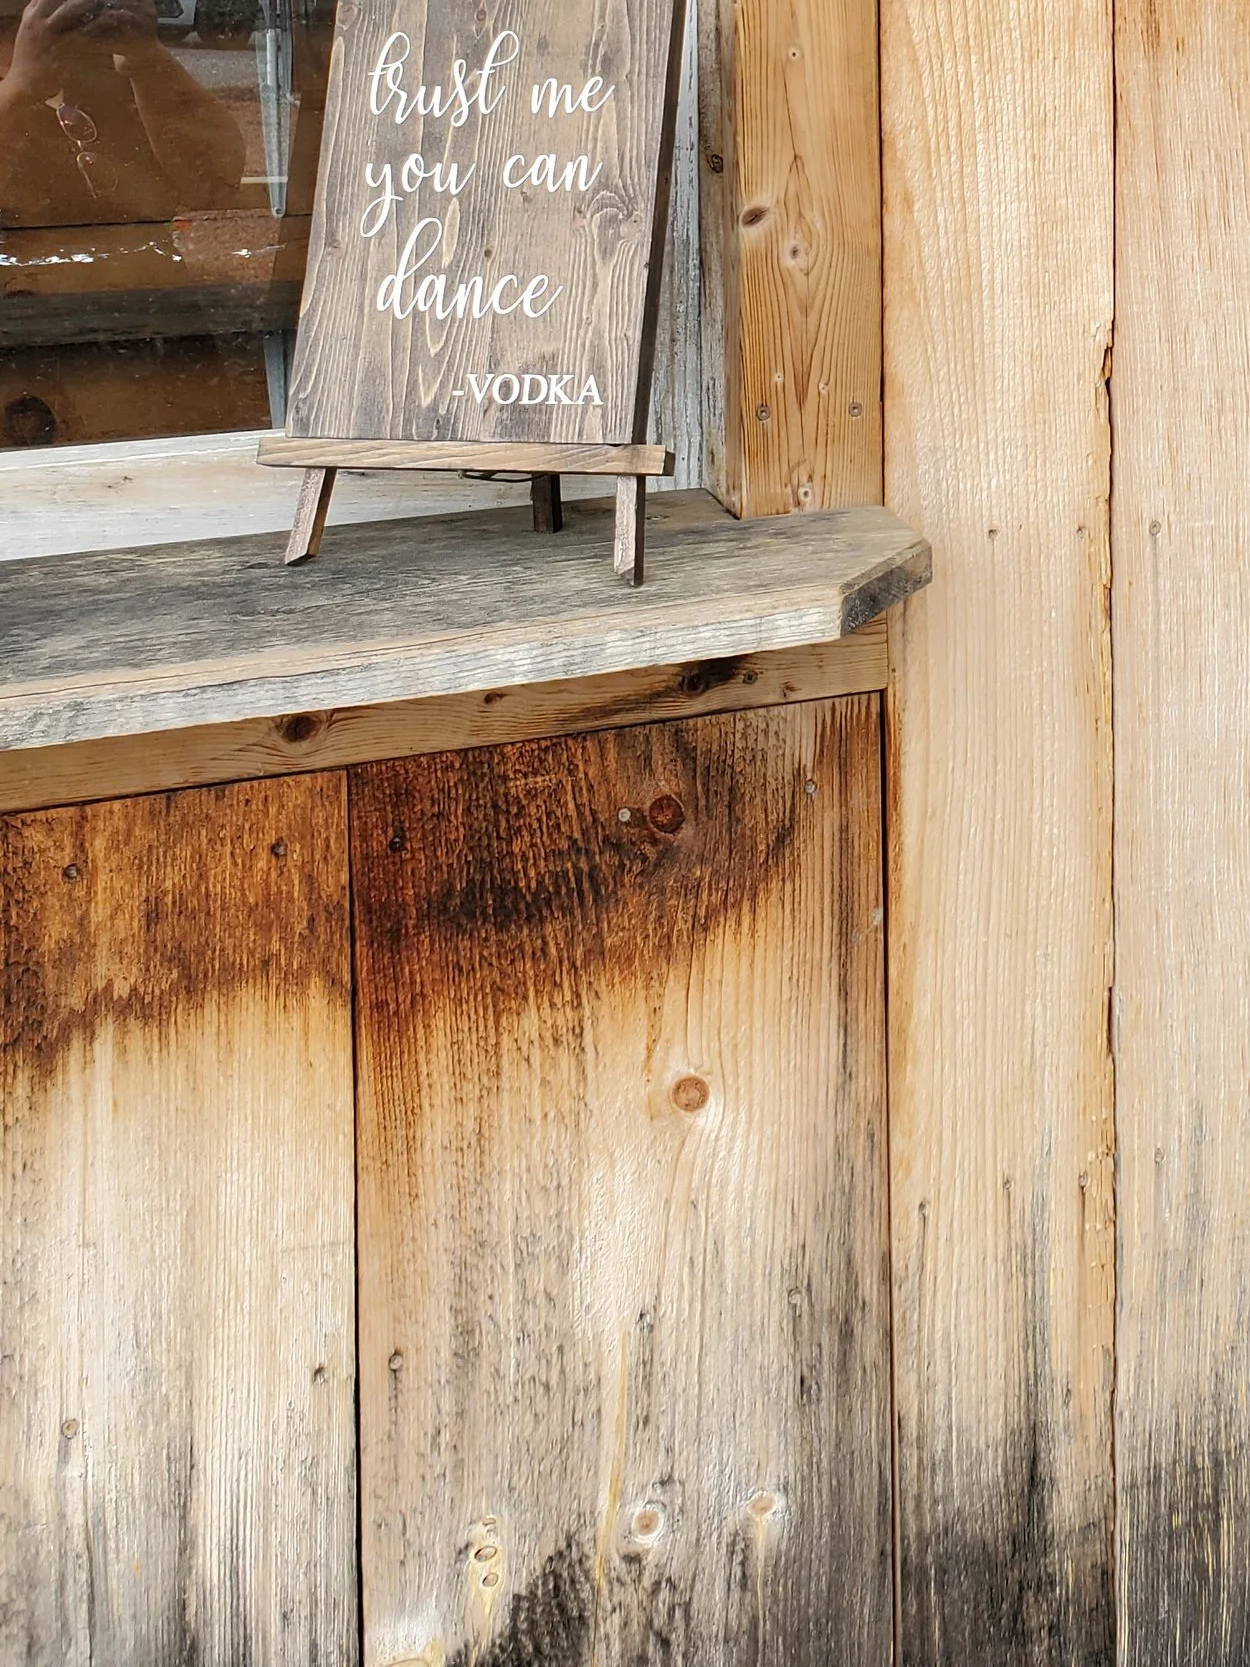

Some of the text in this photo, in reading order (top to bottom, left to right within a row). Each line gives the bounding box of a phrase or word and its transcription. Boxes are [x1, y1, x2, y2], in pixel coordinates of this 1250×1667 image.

[368, 30, 615, 128] trust me
[360, 151, 603, 239] you can
[376, 217, 565, 320] dance
[452, 373, 604, 407] -VODKA
